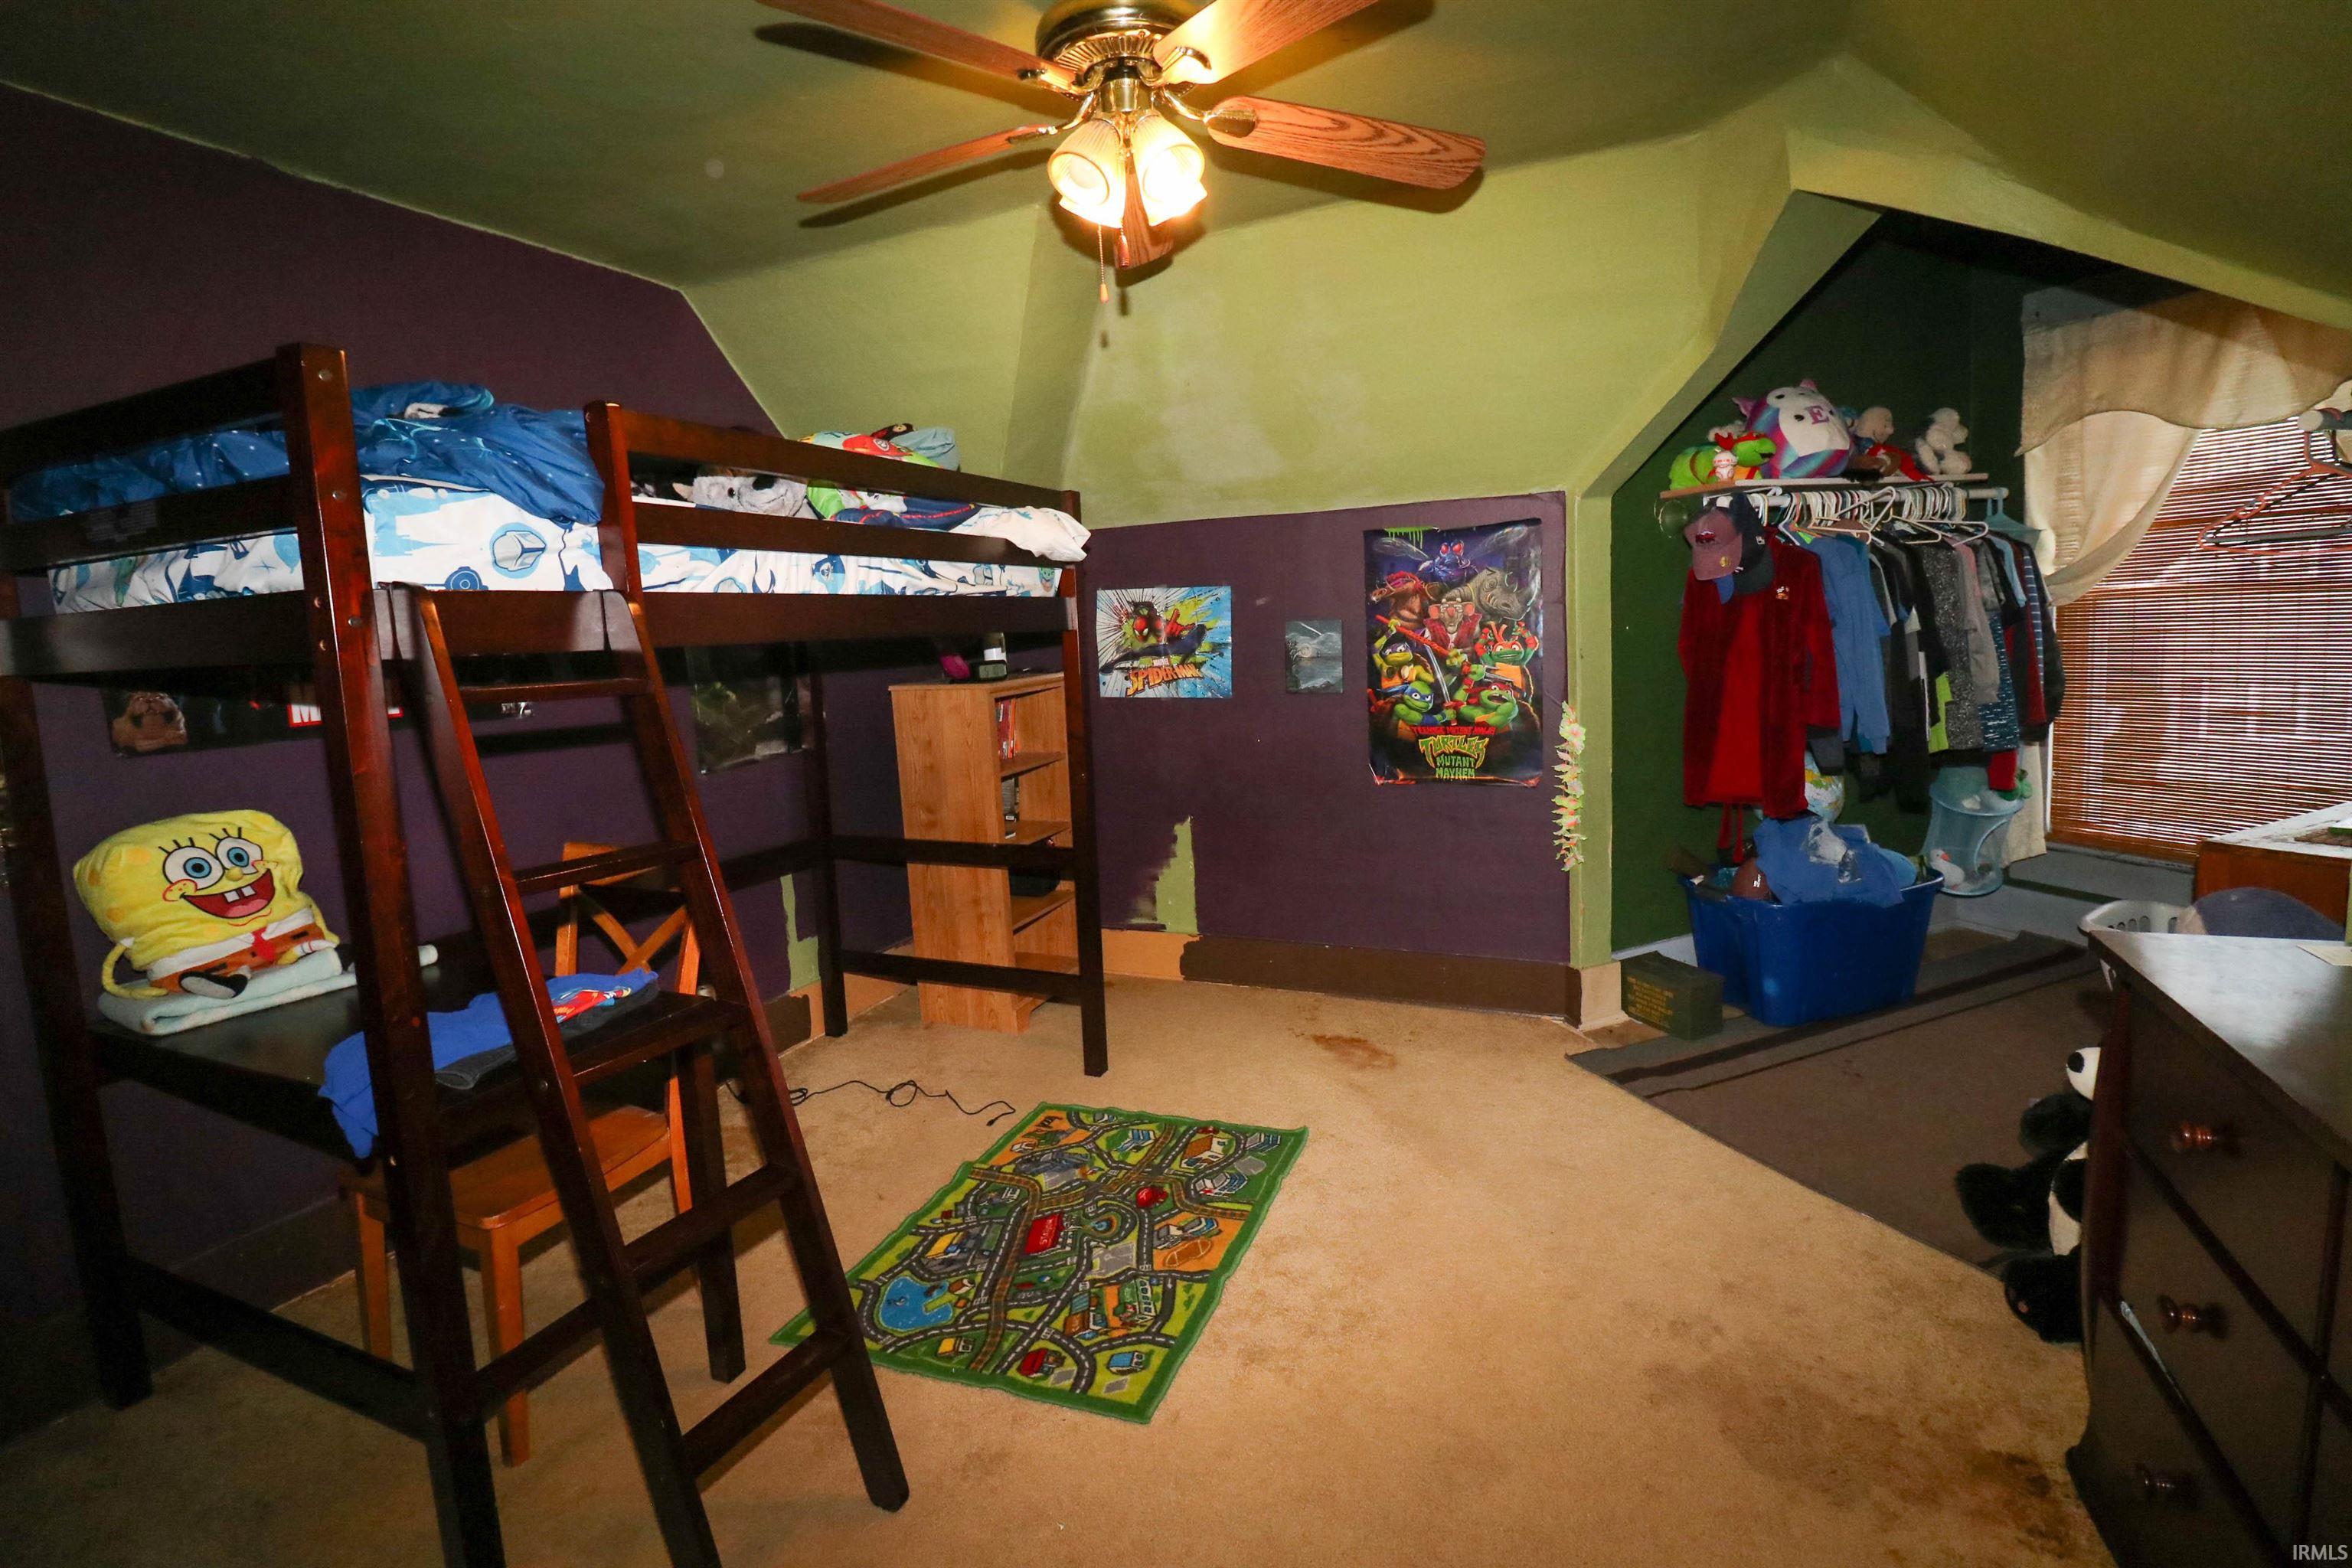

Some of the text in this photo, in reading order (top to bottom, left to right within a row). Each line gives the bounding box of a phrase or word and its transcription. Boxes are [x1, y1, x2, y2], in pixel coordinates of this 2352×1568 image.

[1805, 406, 1830, 424] E
[1125, 663, 1203, 697] SPIDER-MAN
[1418, 734, 1489, 769] TURTLES
[1436, 754, 1476, 766] MUTANT
[1436, 767, 1475, 780] MAYHEM
